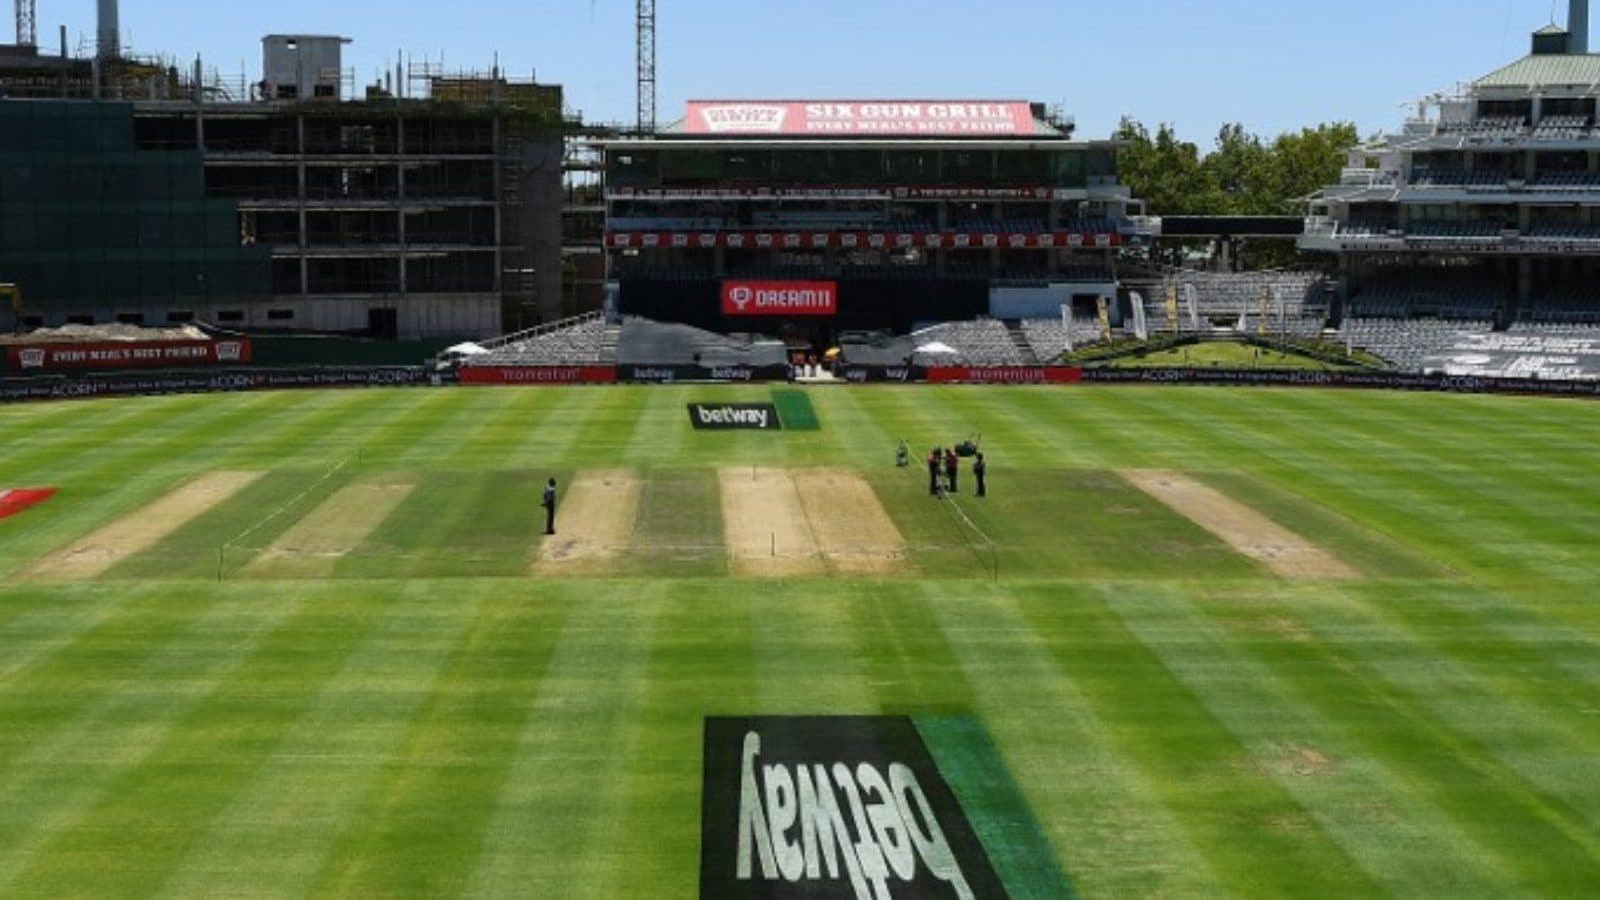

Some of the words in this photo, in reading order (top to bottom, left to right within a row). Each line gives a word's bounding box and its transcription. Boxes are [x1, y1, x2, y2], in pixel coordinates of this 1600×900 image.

[806, 104, 853, 117] SIX
[859, 104, 920, 118] GUN
[927, 104, 1014, 118] GRILL
[806, 120, 851, 130] EVERY
[368, 371, 414, 384] ACORN
[697, 404, 768, 428] betway
[736, 730, 976, 900] betway
